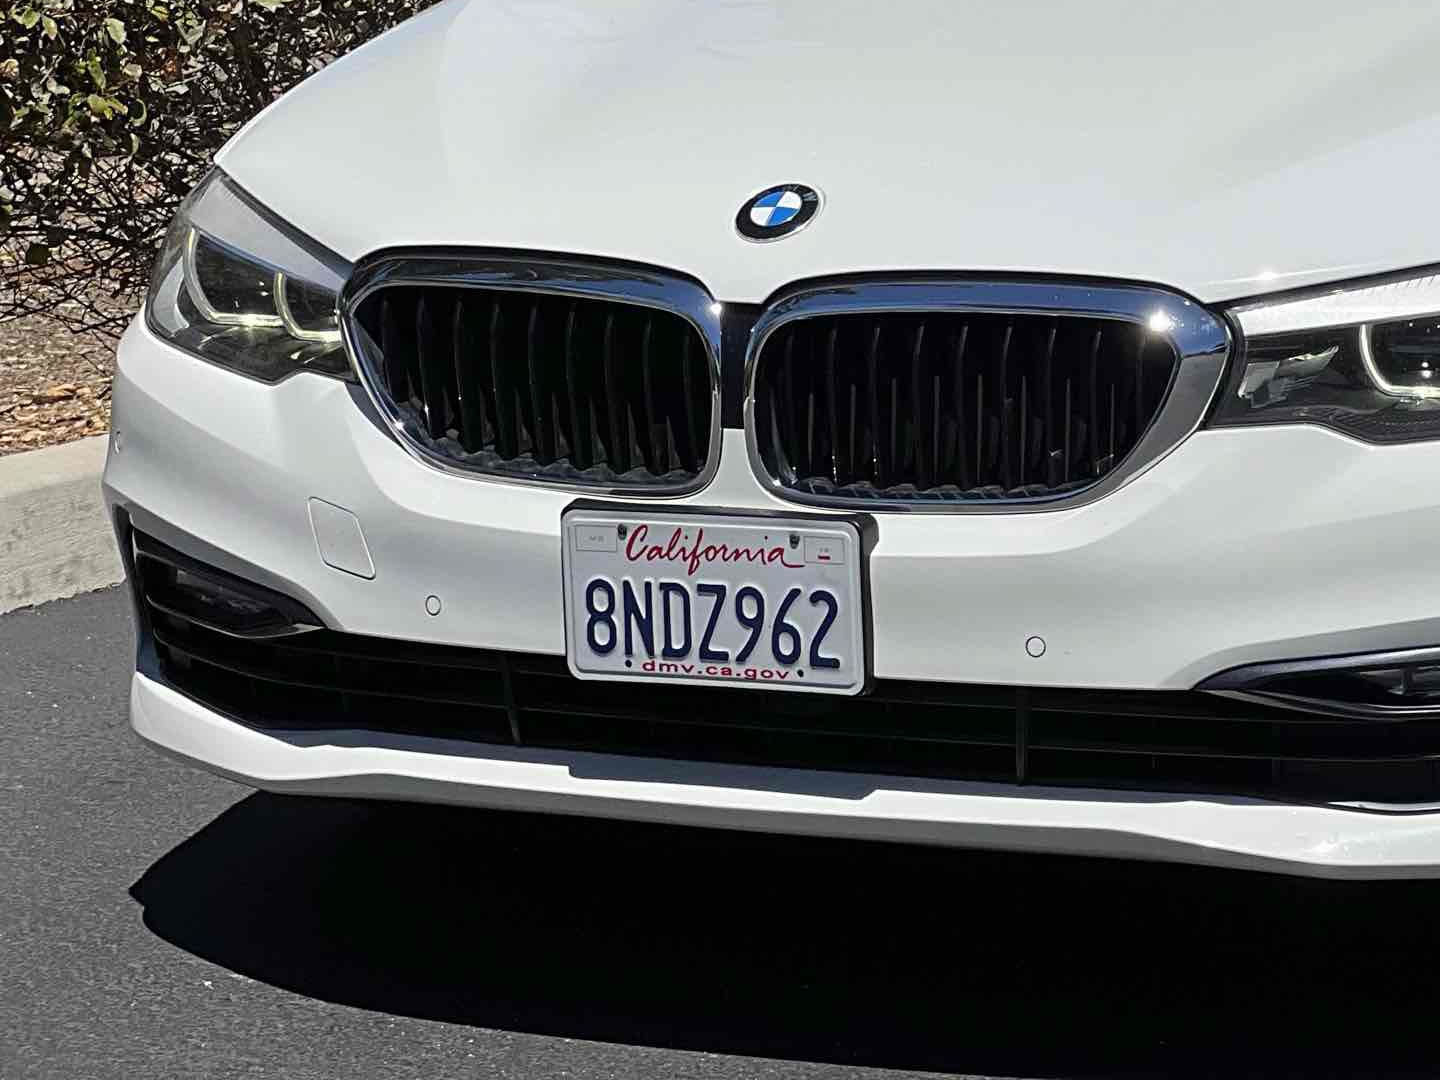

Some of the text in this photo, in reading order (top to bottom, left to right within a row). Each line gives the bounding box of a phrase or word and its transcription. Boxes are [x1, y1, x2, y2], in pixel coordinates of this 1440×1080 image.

[625, 524, 805, 575] California
[585, 578, 841, 669] 8NDZ962
[641, 659, 789, 681] dmv.ca.gov
